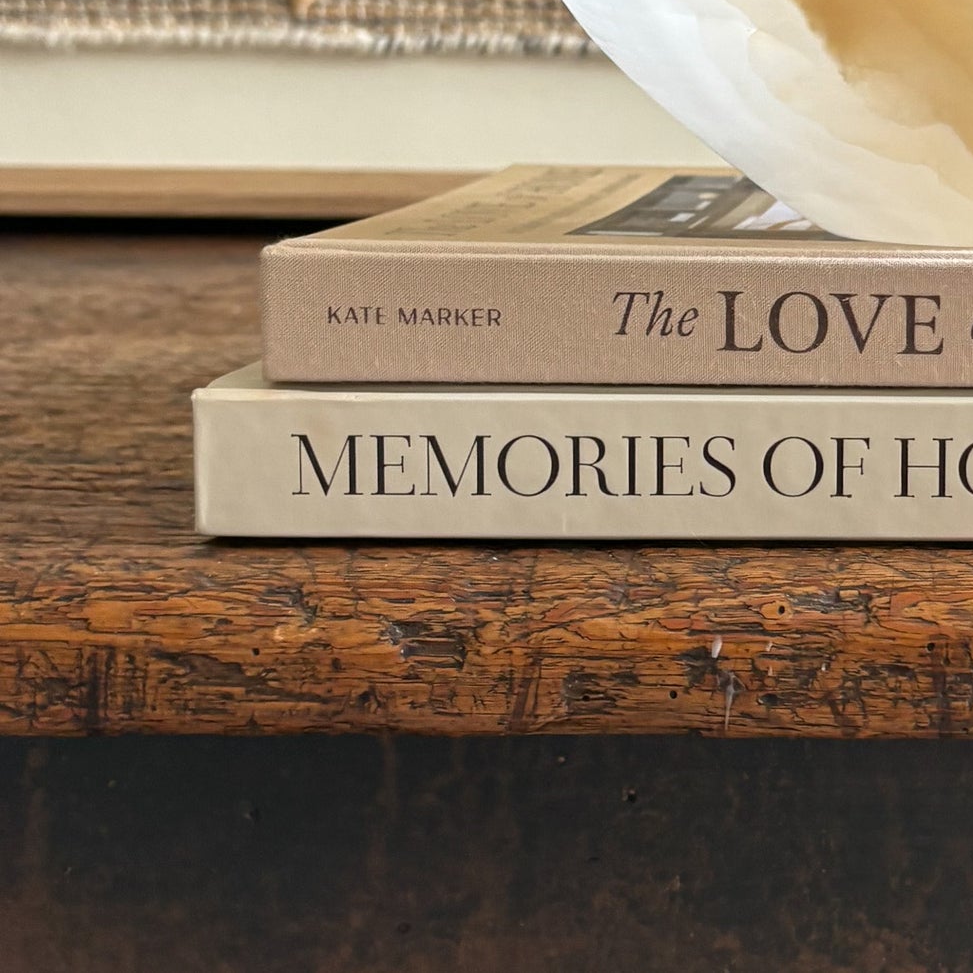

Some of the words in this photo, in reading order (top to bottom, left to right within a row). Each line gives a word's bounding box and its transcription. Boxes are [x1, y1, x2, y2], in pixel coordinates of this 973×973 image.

[328, 306, 386, 325] KATE
[399, 308, 502, 327] MARKER
[613, 290, 700, 337] The
[717, 291, 945, 356] LOVE
[291, 434, 737, 498] MEMORIES
[763, 436, 871, 499] OF
